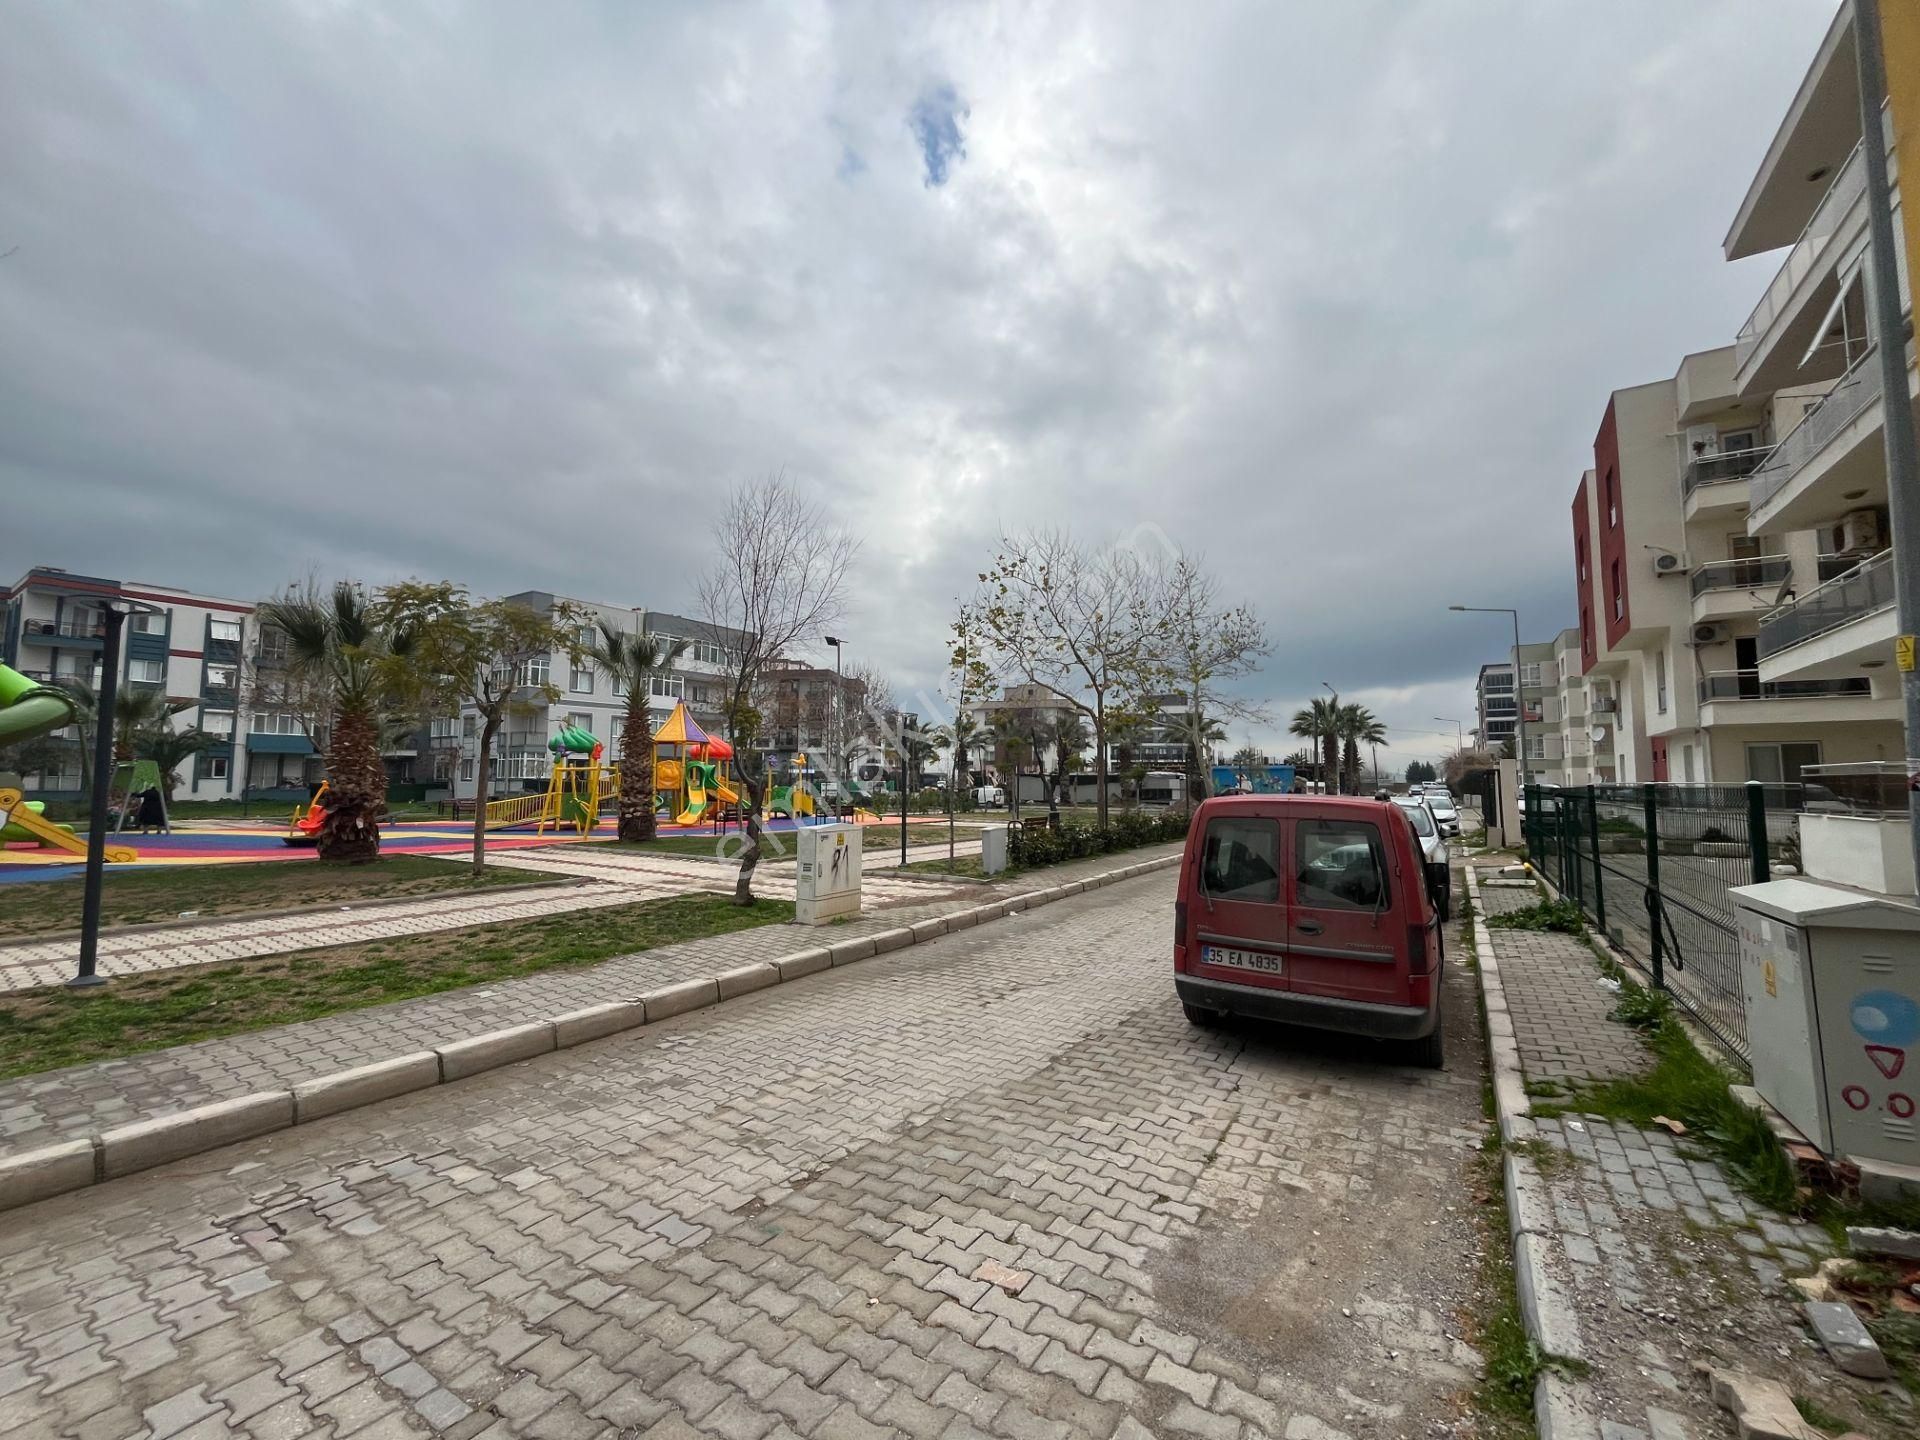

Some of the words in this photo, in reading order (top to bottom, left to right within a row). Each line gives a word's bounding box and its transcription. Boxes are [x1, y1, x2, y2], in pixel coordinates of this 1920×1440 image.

[1209, 948, 1223, 963] 35
[1228, 951, 1243, 966] EA
[1248, 953, 1279, 971] 4835
